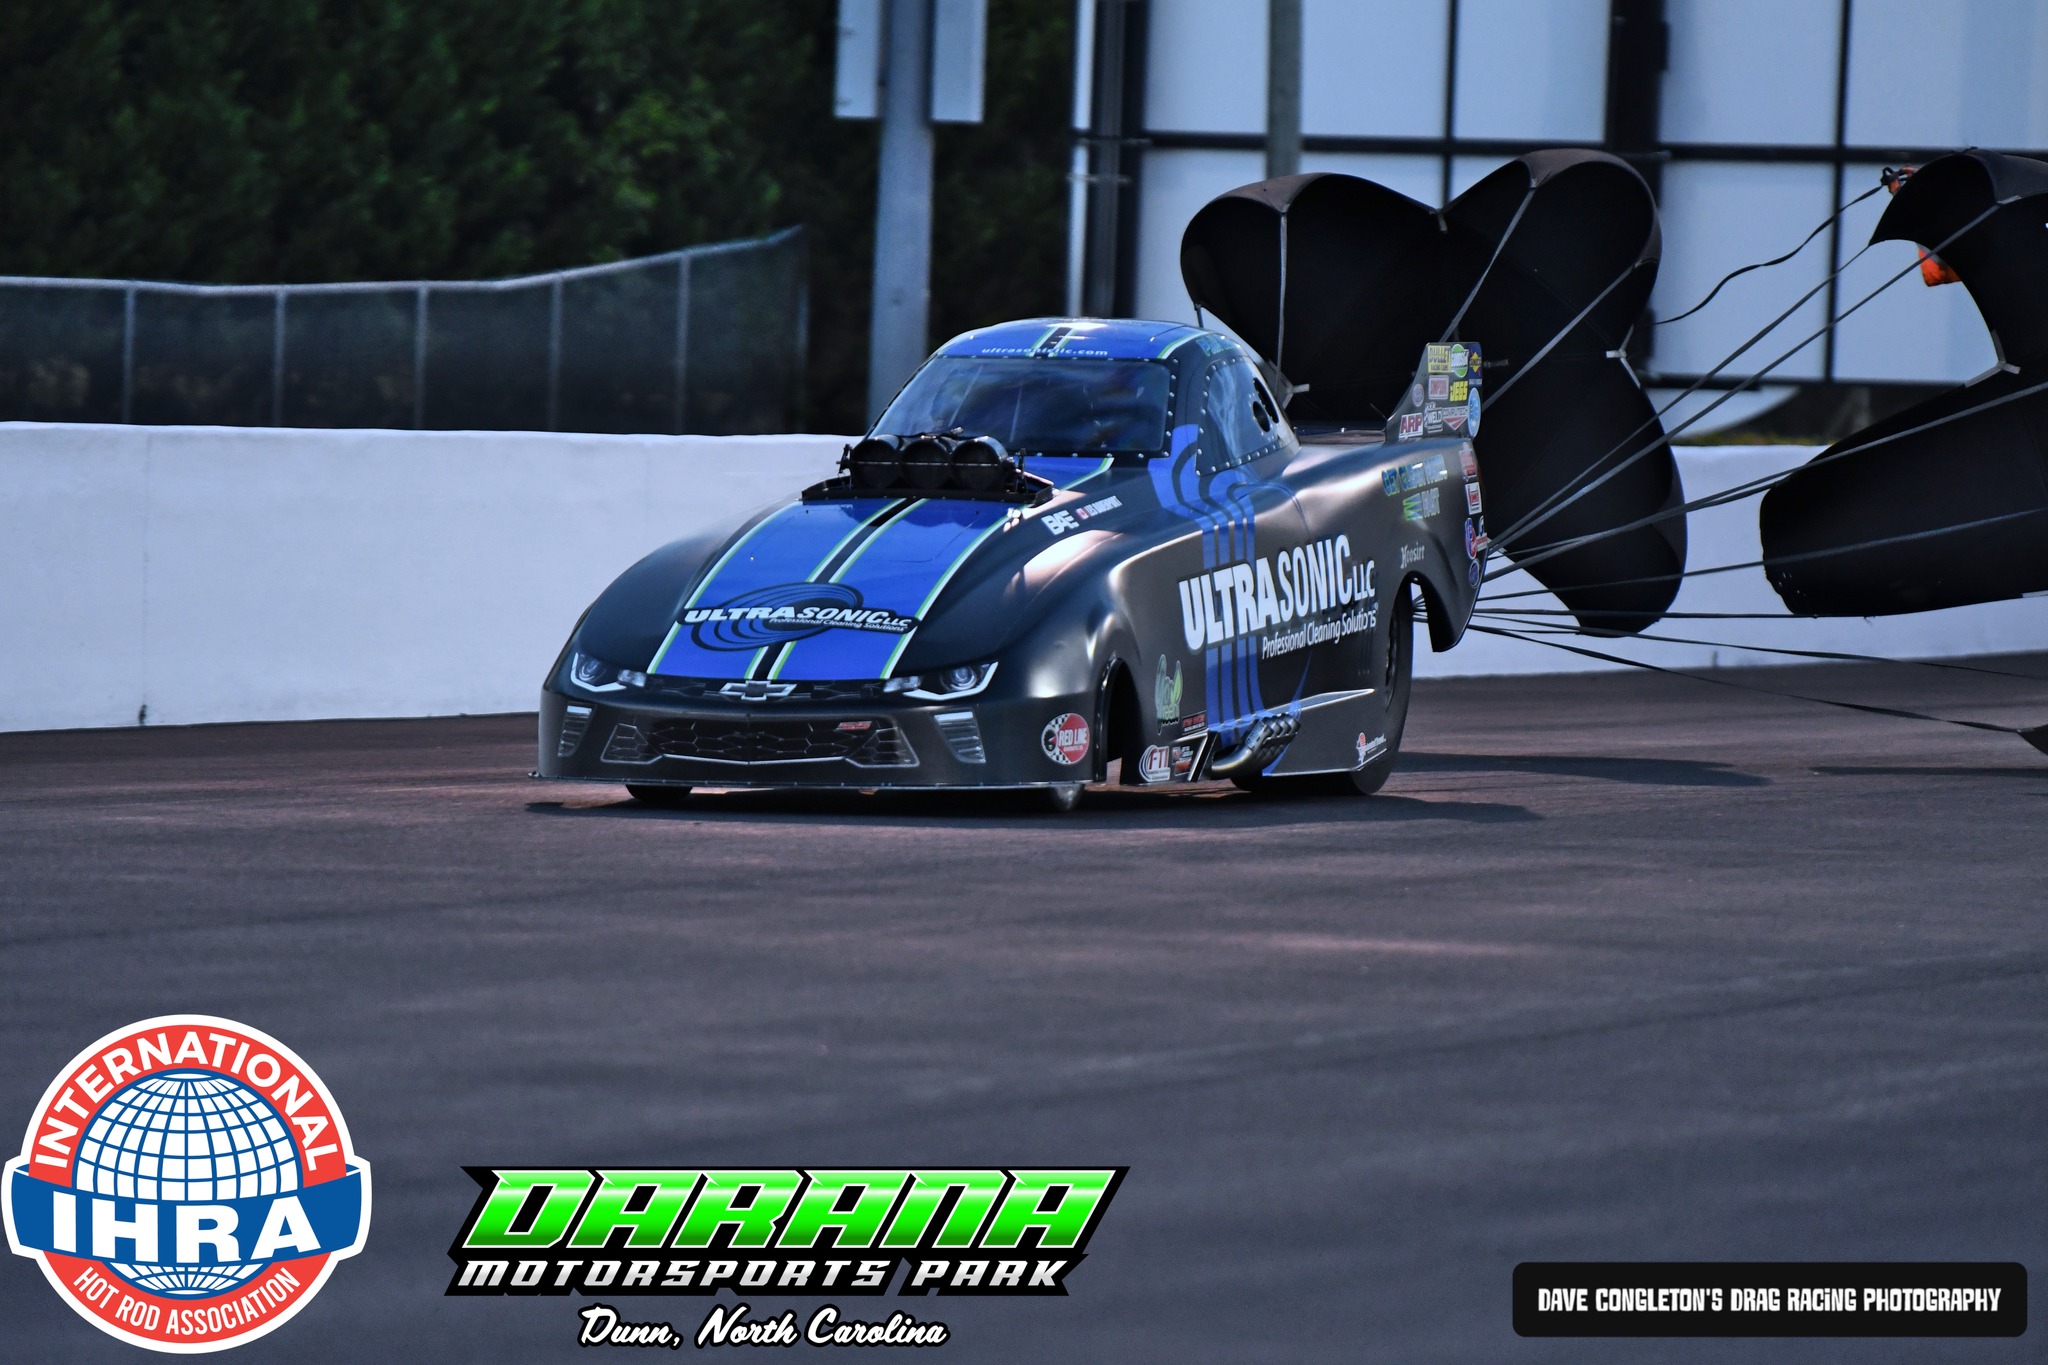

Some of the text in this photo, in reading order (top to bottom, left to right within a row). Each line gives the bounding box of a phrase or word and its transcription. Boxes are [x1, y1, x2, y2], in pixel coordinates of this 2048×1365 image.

[981, 347, 1108, 356] ultrasonicllc.com
[1450, 381, 1468, 402] JEGS
[1401, 414, 1422, 434] ARP
[1041, 510, 1080, 535] BAE
[1400, 542, 1425, 569] Hoosier
[1179, 534, 1376, 650] ULTRASONIC LLC
[684, 606, 912, 627] ULTRASONIC LLC
[769, 617, 907, 632] Professional Cleaning Solutions
[1261, 622, 1306, 660] Professional
[1306, 610, 1340, 646] Cleaning
[1059, 727, 1088, 746] RED LINE
[1149, 750, 1169, 770] FTI
